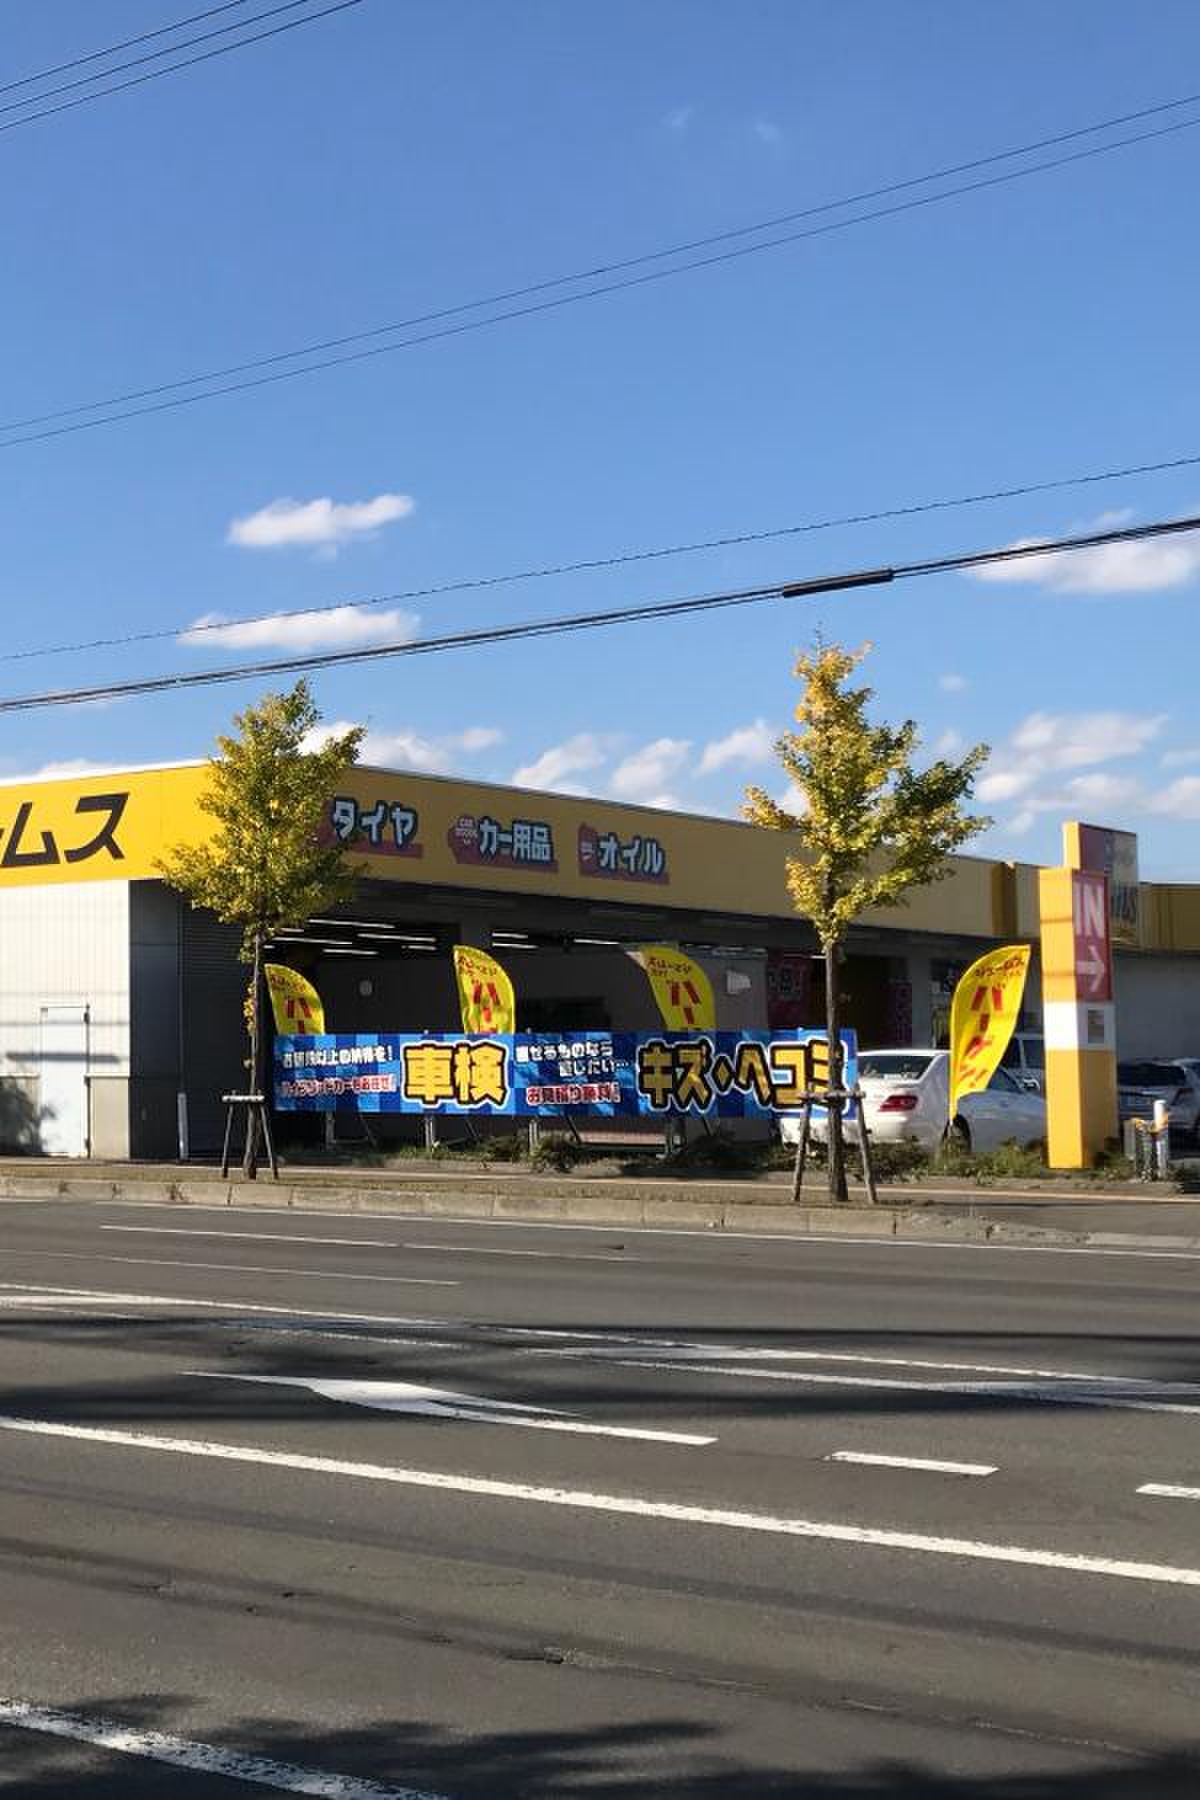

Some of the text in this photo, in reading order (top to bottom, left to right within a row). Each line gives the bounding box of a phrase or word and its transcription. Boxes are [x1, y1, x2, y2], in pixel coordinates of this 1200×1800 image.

[332, 799, 416, 847] タイヤ
[479, 818, 551, 863] カー用品
[599, 836, 663, 875] オイル
[1073, 882, 1104, 940] IN
[402, 1042, 509, 1107] 車検
